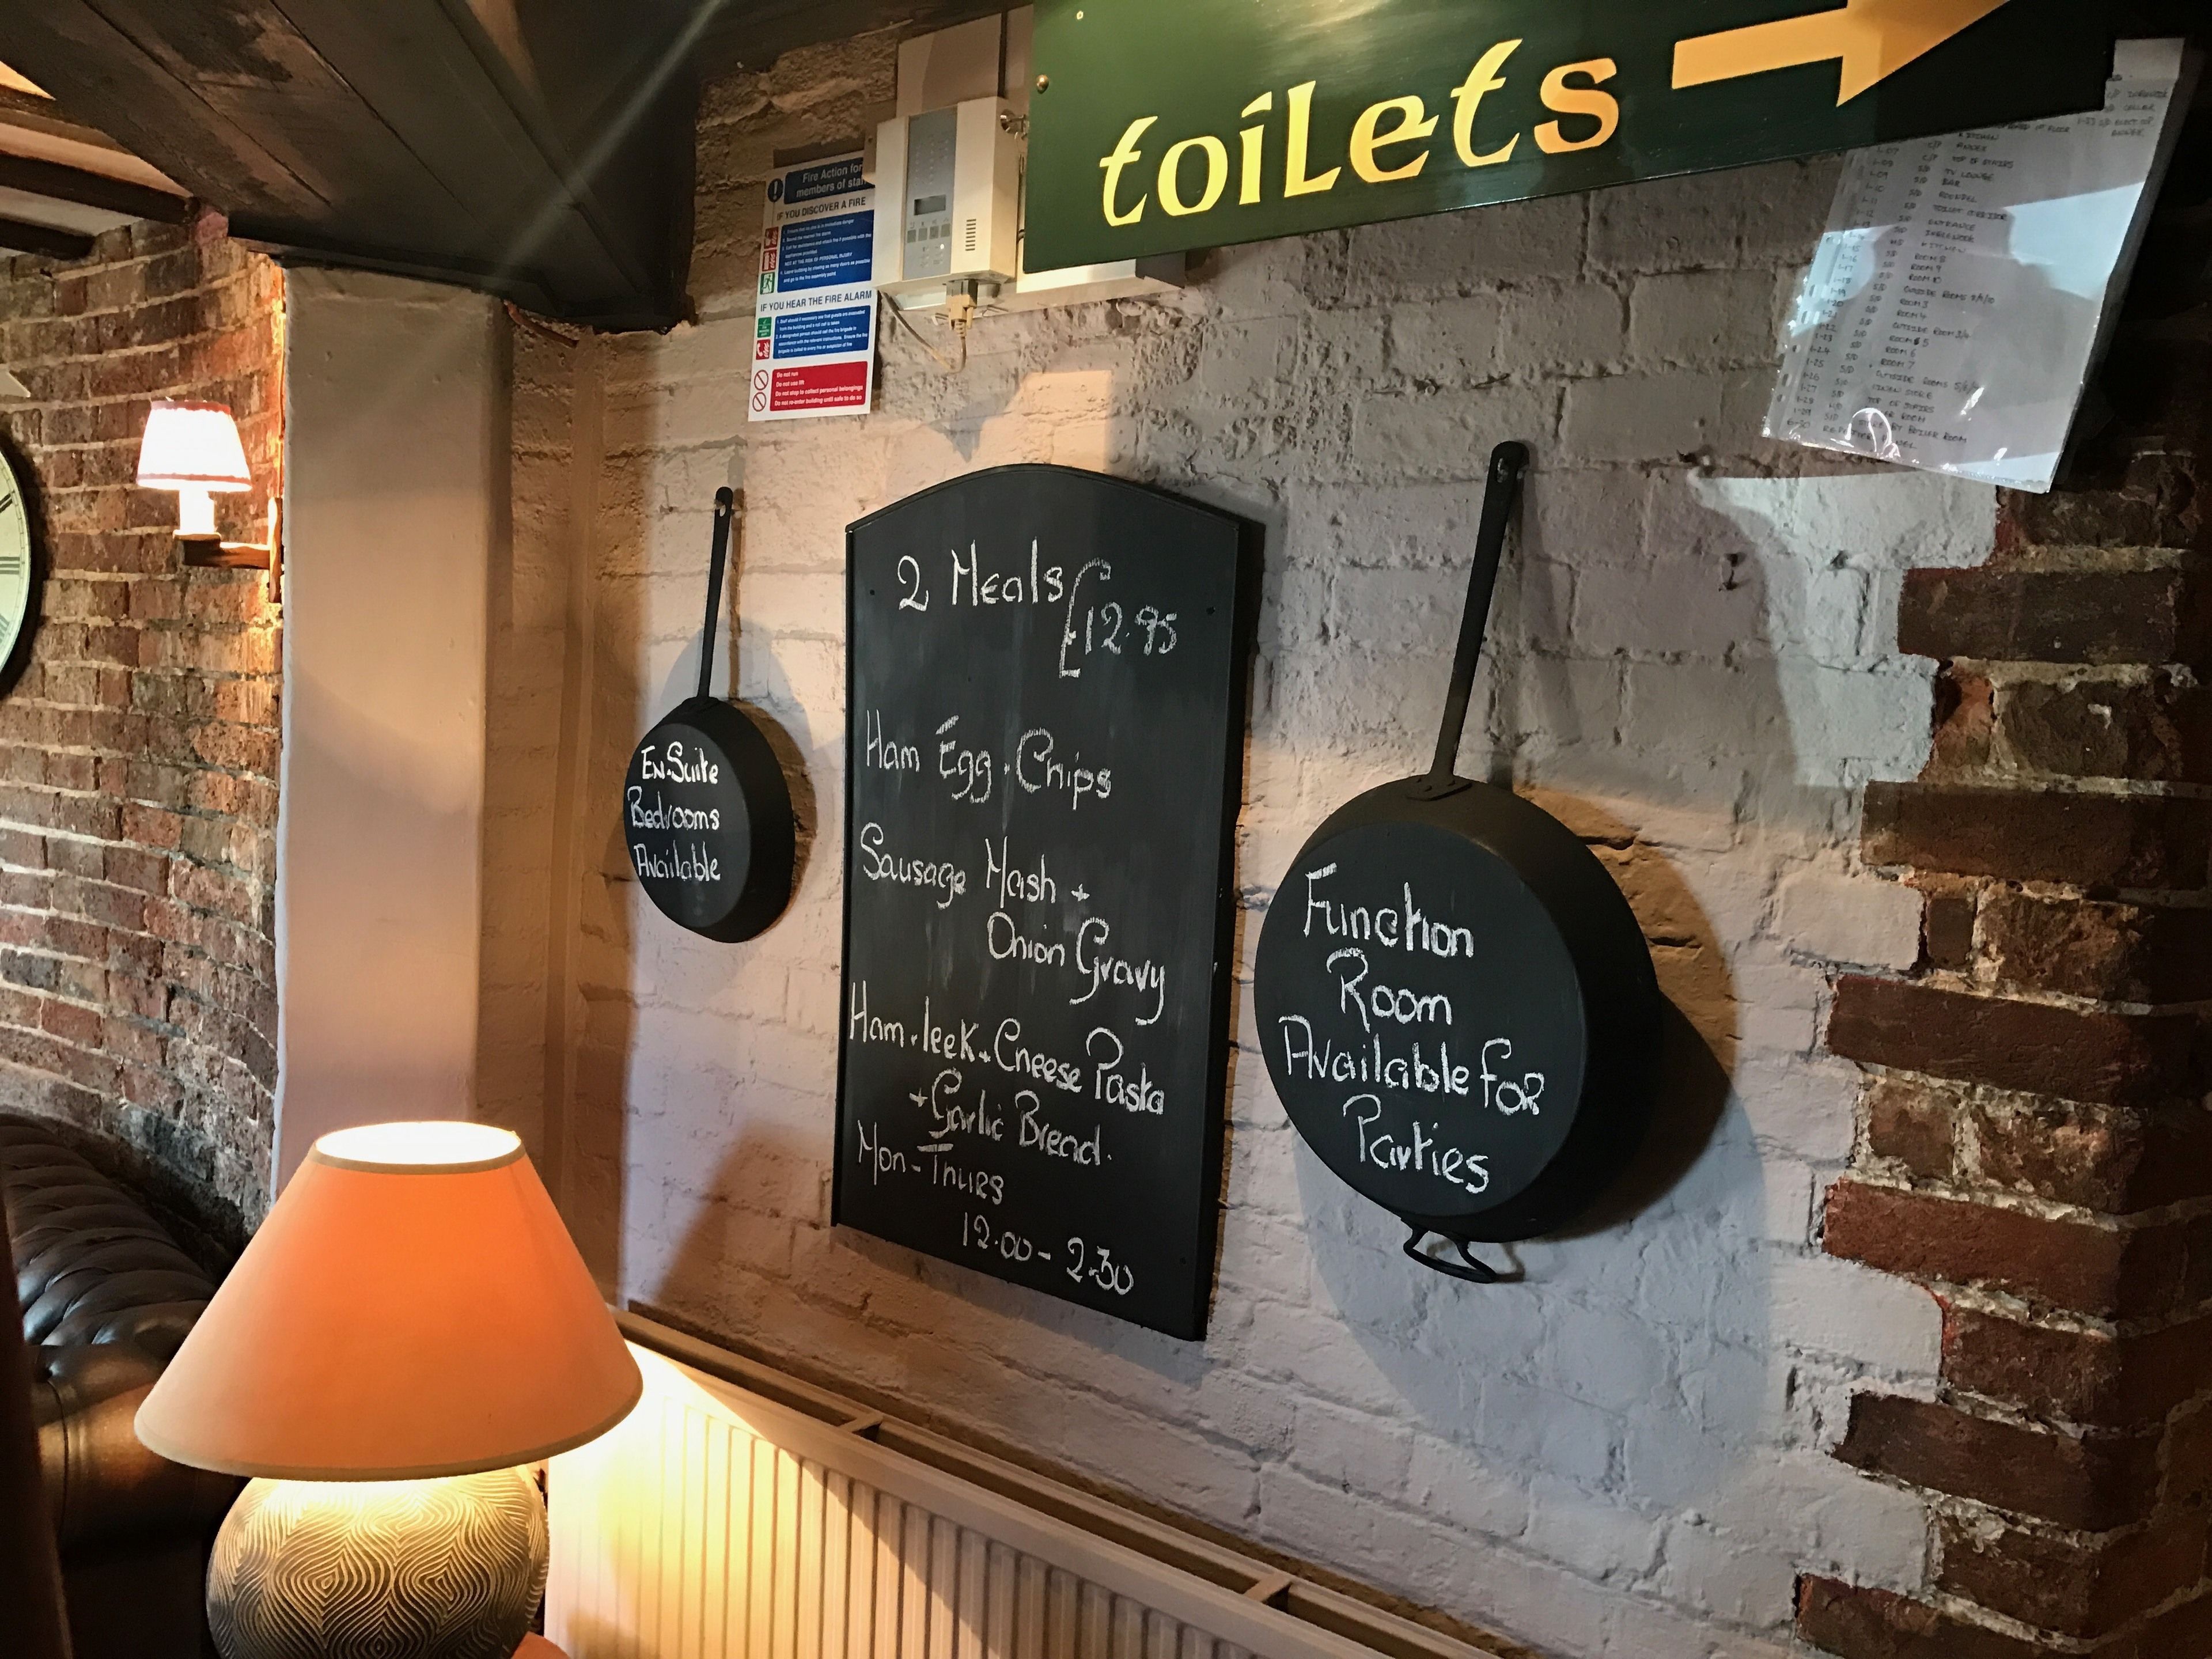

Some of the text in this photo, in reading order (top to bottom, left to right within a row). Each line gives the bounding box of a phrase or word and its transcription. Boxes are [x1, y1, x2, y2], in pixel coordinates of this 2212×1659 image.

[802, 163, 863, 183] Fire Action for
[1100, 39, 1618, 226] toilets
[777, 197, 866, 221] IF YOU DISCOVER A FIRE
[796, 183, 835, 198] members
[837, 180, 846, 189] of
[760, 290, 872, 312] IF YOU HEAR THE FIRE ALARM
[897, 537, 1177, 679] 2 Meals £12.95
[866, 709, 920, 772] Ham
[1016, 727, 1111, 810] Chips
[627, 786, 719, 830] Bedrooms
[634, 840, 720, 881] Available
[861, 822, 967, 910] Sausage
[985, 836, 1056, 908] Mash
[1304, 862, 1474, 957] Function
[987, 911, 1165, 1025] Onion Gravy
[1326, 947, 1452, 1033] Room
[1086, 1027, 1165, 1115] Pasta
[1278, 1014, 1469, 1096] Available
[929, 1067, 1004, 1142] Garlic
[1343, 1093, 1489, 1194] Parties
[1066, 1237, 1134, 1294] 2.30
